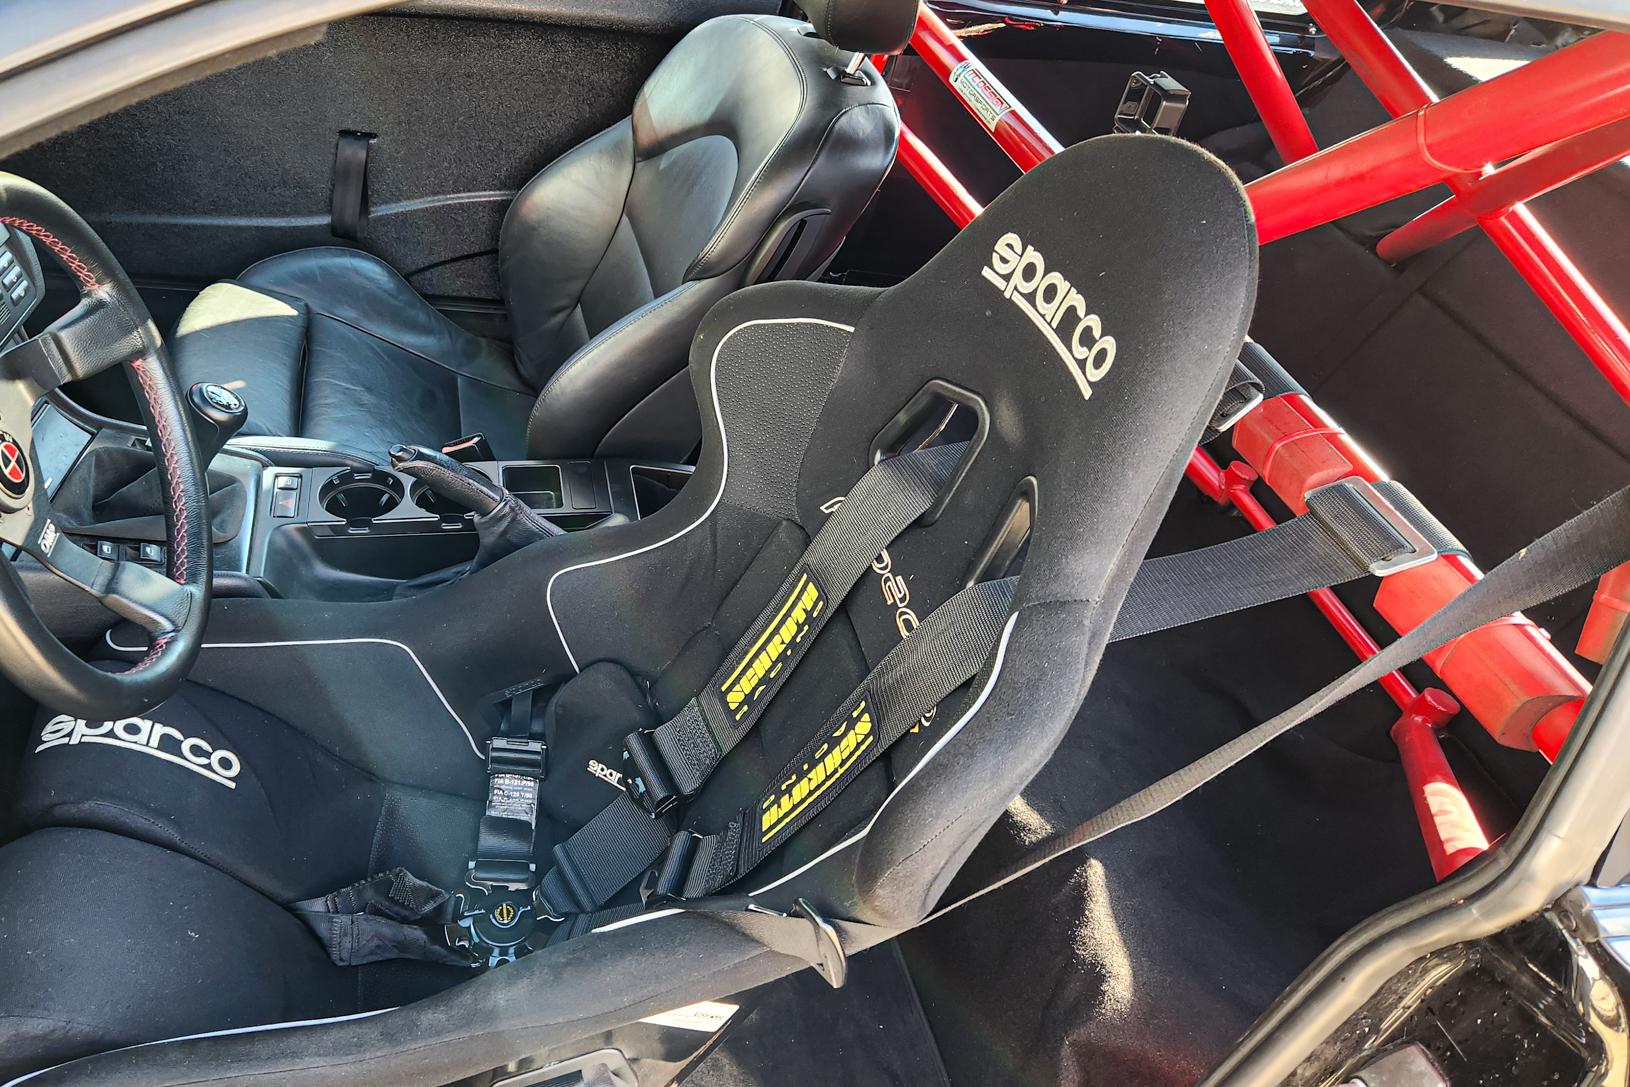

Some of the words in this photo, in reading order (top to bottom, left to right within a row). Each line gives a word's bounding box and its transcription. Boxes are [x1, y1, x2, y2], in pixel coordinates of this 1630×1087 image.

[988, 232, 1117, 386] sparco
[726, 581, 819, 710] SCHROTH
[735, 600, 823, 721] RACING
[40, 714, 241, 778] sparco
[588, 759, 633, 785] spar
[761, 712, 873, 832] SCHROTH
[762, 700, 866, 810] RACING
